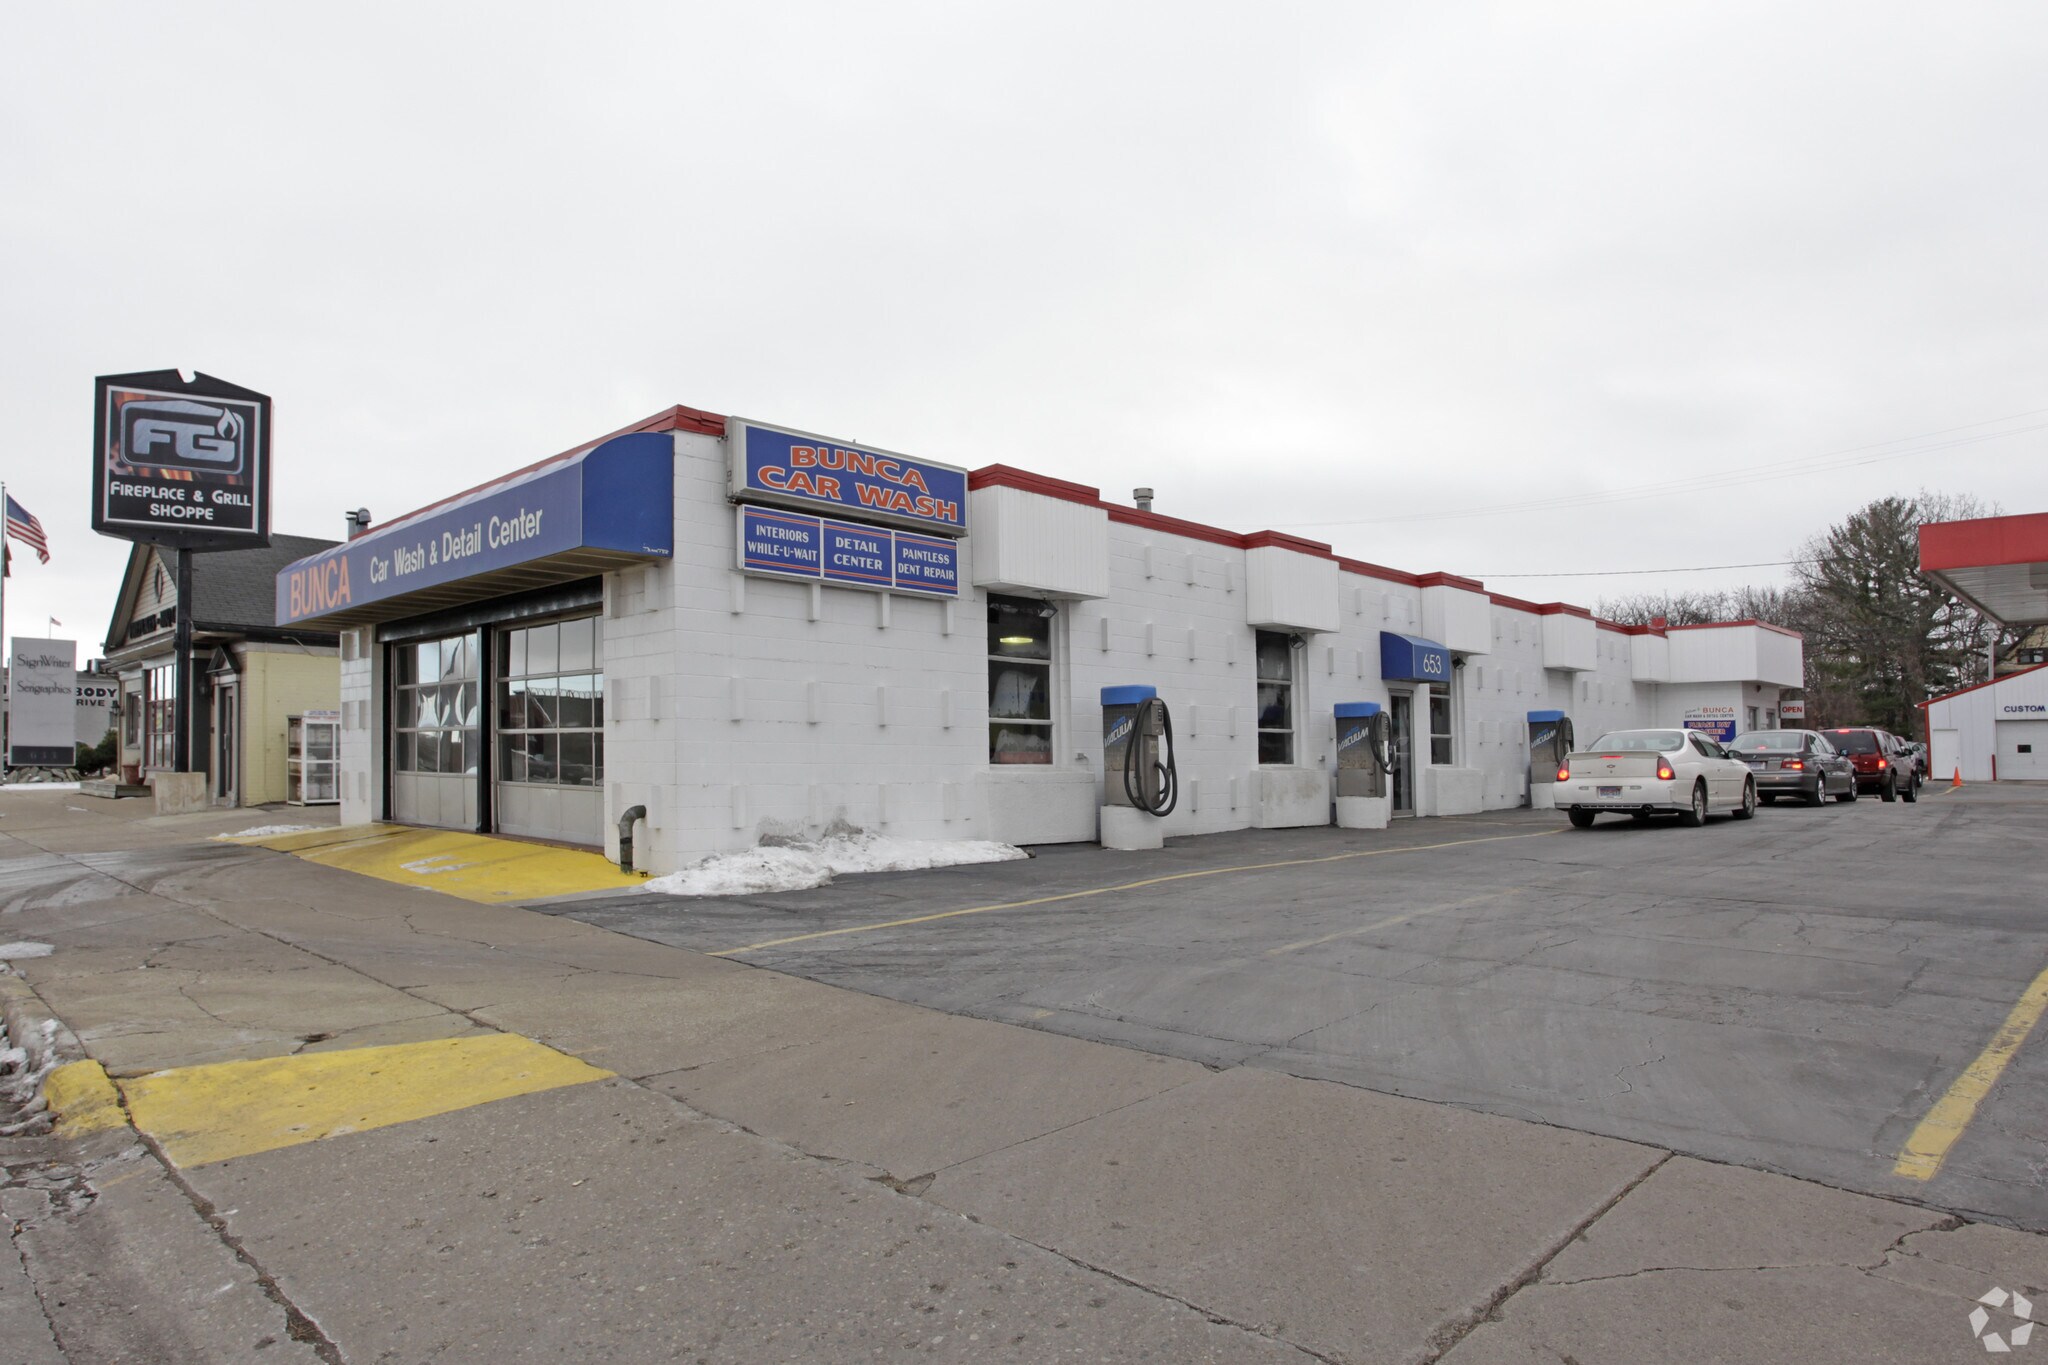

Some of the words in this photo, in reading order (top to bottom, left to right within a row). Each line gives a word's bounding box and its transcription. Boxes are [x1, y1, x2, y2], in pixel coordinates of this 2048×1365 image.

[132, 418, 236, 463] FG
[790, 445, 930, 495] BUNCA
[110, 481, 185, 501] FIREPLACE
[193, 490, 204, 503] &
[211, 489, 252, 507] GRILL
[757, 465, 842, 501] CAR
[854, 482, 958, 523] WASH
[150, 503, 214, 520] SHOPPE
[756, 524, 809, 543] INTERIORS
[747, 541, 818, 562] WHILE-U-WAIT
[835, 536, 881, 554] DETAIL
[289, 555, 351, 618] BUNCA
[370, 556, 389, 584] Car
[394, 543, 425, 577] Wash
[429, 540, 438, 566] &
[442, 523, 482, 563] Detail
[488, 508, 543, 549] Center
[833, 553, 883, 571] CENTER
[902, 547, 950, 565] PAINTLESS
[898, 562, 920, 576] DENT
[924, 566, 955, 581] REPAIR
[1423, 653, 1442, 675] 653
[1702, 706, 1734, 714] BUNCA
[2003, 705, 2047, 713] CUSTOM
[1337, 727, 1369, 752] VACUUM
